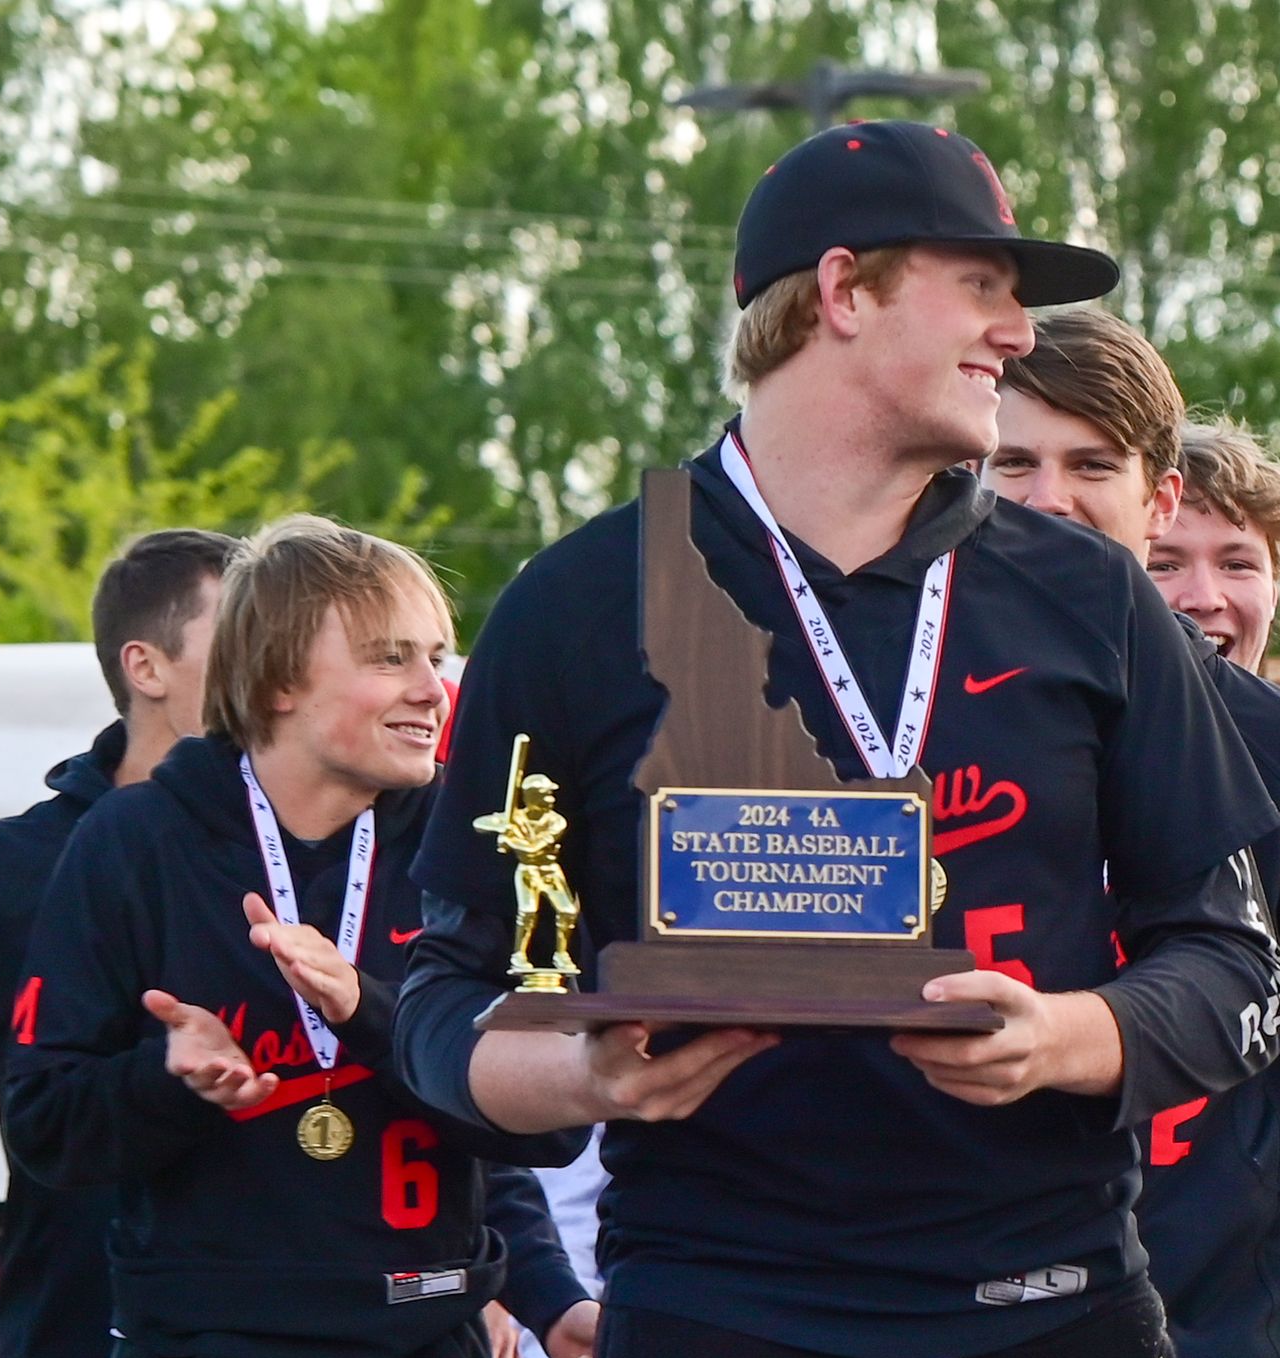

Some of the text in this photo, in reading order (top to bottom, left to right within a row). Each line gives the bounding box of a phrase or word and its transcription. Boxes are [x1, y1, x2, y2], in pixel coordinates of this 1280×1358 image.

[809, 617, 834, 657] 2024
[920, 620, 936, 660] 2024
[851, 712, 880, 753] 2024
[897, 723, 917, 766] 2024
[738, 804, 840, 827] 2024 4A
[671, 831, 905, 857] STATE BASEBALL
[691, 861, 888, 886] TOURNAMENT
[713, 891, 863, 915] CHAMPION
[381, 1120, 439, 1229] 6
[1045, 1271, 1058, 1288] L
